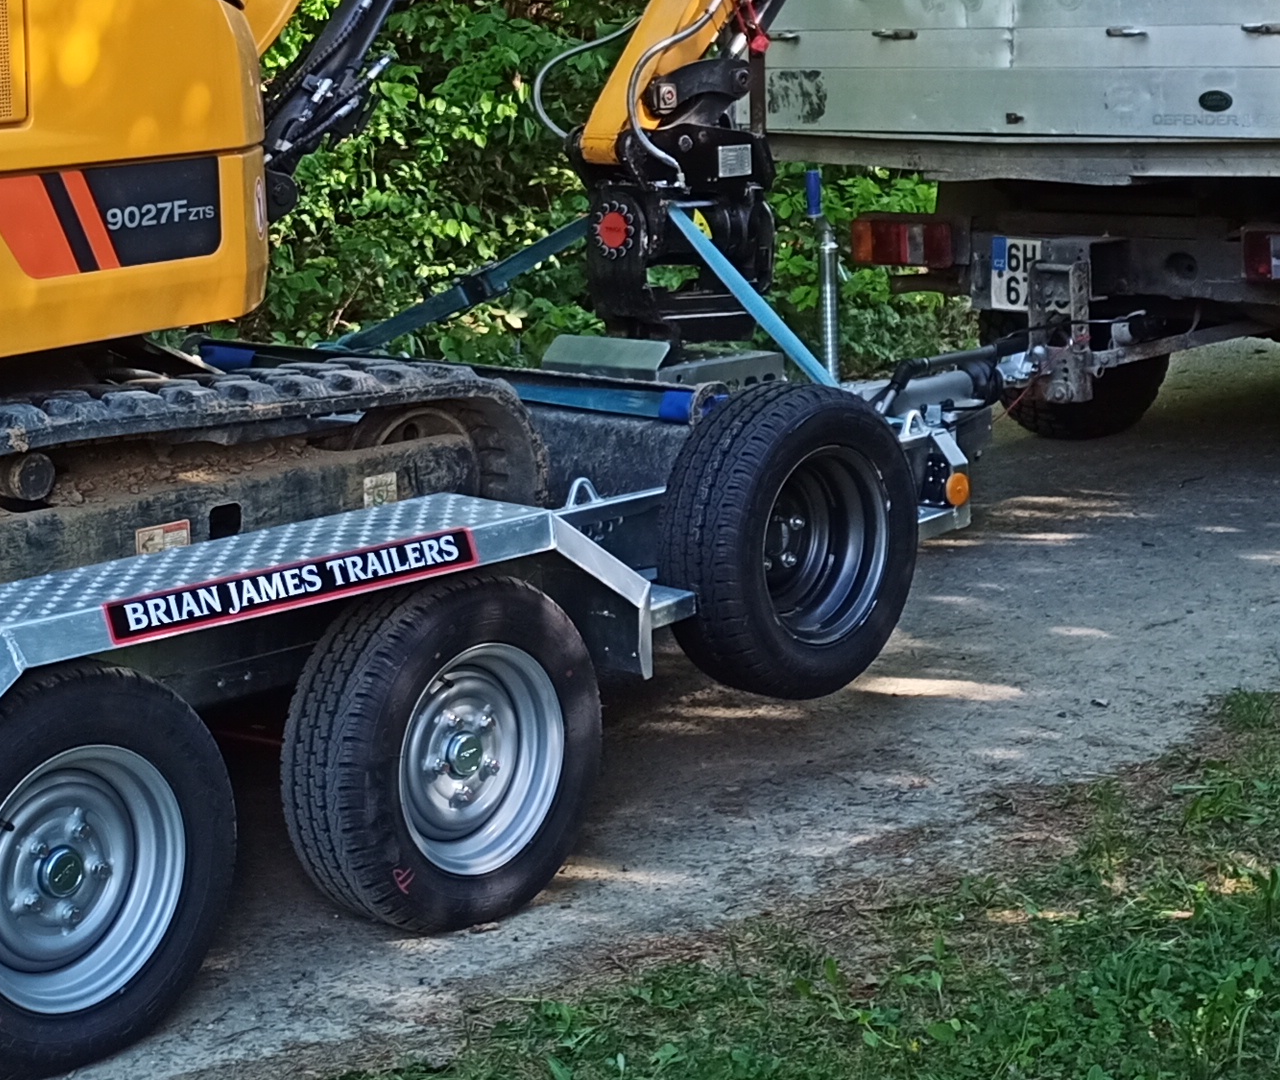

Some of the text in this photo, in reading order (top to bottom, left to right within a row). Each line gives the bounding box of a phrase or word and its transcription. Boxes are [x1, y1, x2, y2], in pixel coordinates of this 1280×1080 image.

[123, 534, 460, 632] BRIAN JAMES TRAILERS
